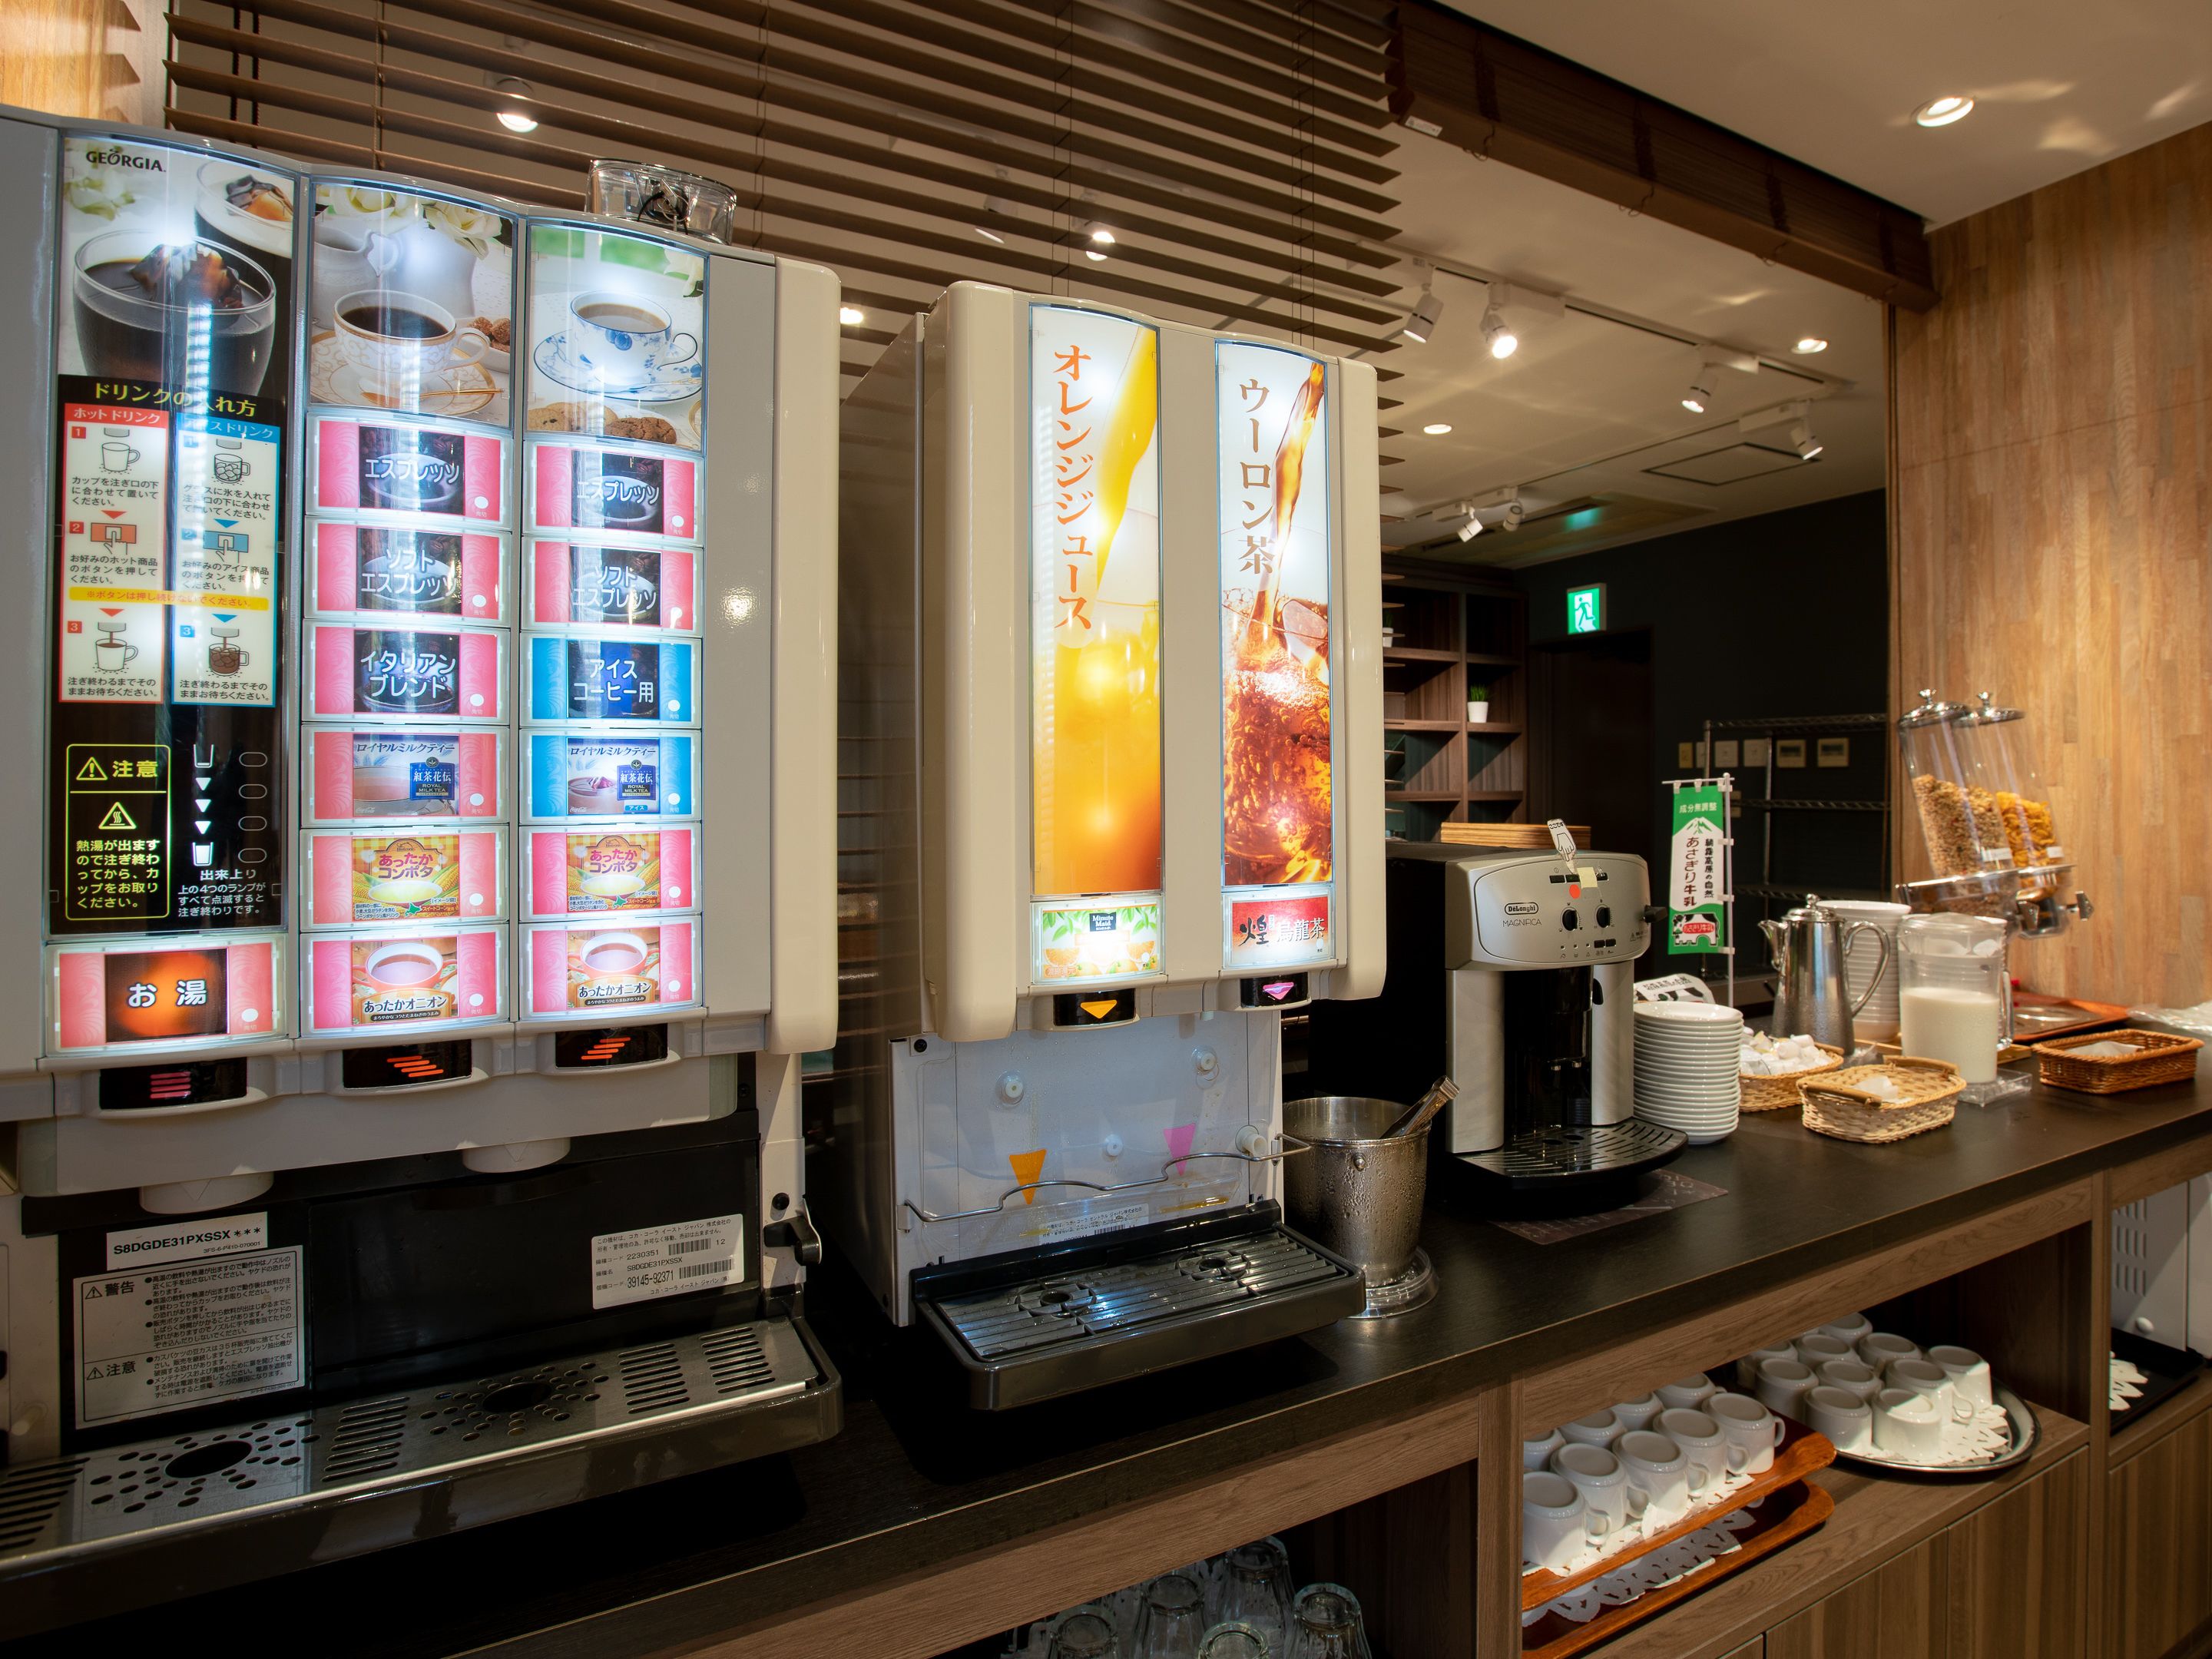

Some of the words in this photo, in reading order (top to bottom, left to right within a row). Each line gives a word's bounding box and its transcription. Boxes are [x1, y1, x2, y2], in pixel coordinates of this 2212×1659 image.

[86, 148, 164, 172] GEORGIA
[74, 408, 161, 423] ホットドリンク
[185, 417, 273, 439] スドリンク
[366, 459, 459, 484] エスプレッソ
[1237, 378, 1277, 575] ウーロン茶
[71, 476, 159, 489] カップを注ぎ口の下
[1052, 345, 1094, 631] オレンジジュース
[71, 486, 159, 500] に合わせて置いて
[577, 481, 660, 505] エスプレッソ
[71, 497, 115, 507] ください。
[71, 554, 158, 567] お好みのホット商品
[386, 549, 435, 571] ソフト
[70, 565, 157, 577] のボタンを押して
[595, 565, 637, 587] ソフト
[71, 575, 114, 584] ください。
[182, 579, 227, 591] ください。
[361, 573, 458, 598] エスプレッソ
[361, 651, 456, 674] イタリアン
[589, 659, 637, 679] アイス
[68, 677, 156, 687] 注ぎ終わるまでその
[180, 680, 268, 690] 注ぎ終わるまでその
[370, 674, 445, 698] ブレンド
[68, 687, 157, 697] ままお待ちください。
[180, 690, 269, 701] ままお待ちください。
[574, 681, 654, 704] コーヒー用
[357, 742, 455, 753] ロイヤルミルクティー
[570, 745, 657, 757] ロイヤルミルクティー
[112, 760, 158, 778] 注意
[413, 770, 452, 783] 紅茶花伝
[620, 772, 653, 783] 紅茶花伝
[1679, 802, 1717, 814] 成分無調整
[76, 839, 160, 852] 熱湯が出ます
[77, 854, 160, 866] ので注ぎ終わ
[378, 853, 434, 867] あったか
[589, 848, 637, 861] あったか
[77, 868, 159, 879] ってから、カ
[378, 866, 434, 879] コンポタ
[589, 860, 637, 874] コンポタ
[1684, 836, 1700, 907] あさぎり牛乳
[200, 869, 257, 882] 出来上り
[78, 882, 158, 895] ップをお取り
[178, 882, 266, 895] 上の4つのランプが
[77, 897, 138, 909] ください。
[178, 893, 264, 906] すべて点滅すると
[178, 905, 260, 917] 注ぎ終わりです。
[1503, 918, 1542, 928] MAGNIFICA
[1683, 924, 1714, 932] あさぎり牛乳
[127, 979, 207, 1008] お湯
[578, 982, 651, 998] あったかオニオン
[364, 995, 448, 1014] あったかオニオン
[114, 1230, 230, 1255] S8DGDE31PXSSX
[627, 1250, 659, 1260] 2230351
[627, 1270, 674, 1289] 39145-92371
[104, 1281, 135, 1297] 警告
[106, 1361, 136, 1377] 注意
